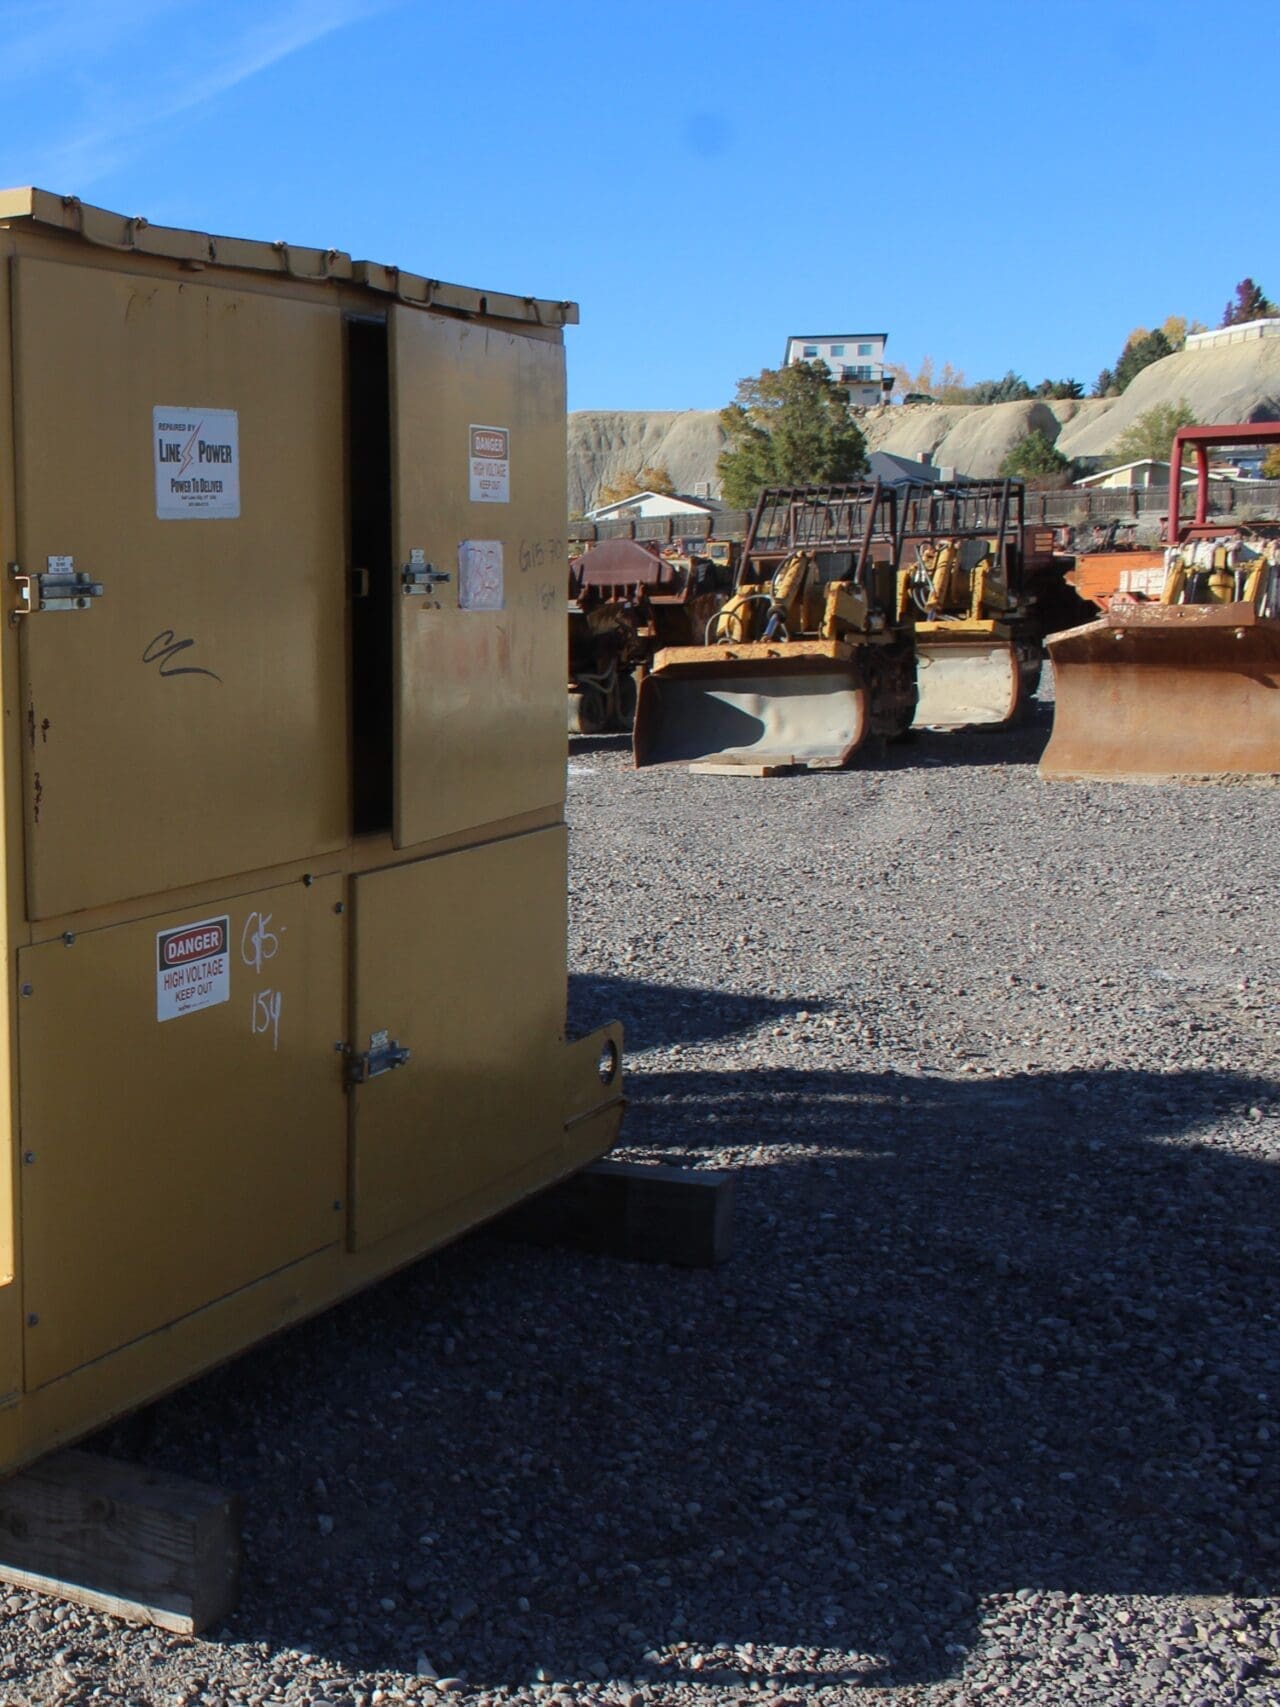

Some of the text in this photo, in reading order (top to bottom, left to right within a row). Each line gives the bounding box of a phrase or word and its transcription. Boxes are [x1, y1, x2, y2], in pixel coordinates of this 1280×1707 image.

[158, 422, 196, 432] REPAIRED BY
[158, 438, 232, 464] LINE POWER
[168, 930, 219, 959] DANGER
[163, 958, 224, 991] HIGH VOLTAGE
[175, 981, 214, 1002] KEEP OUT
[252, 988, 281, 1052] 154
